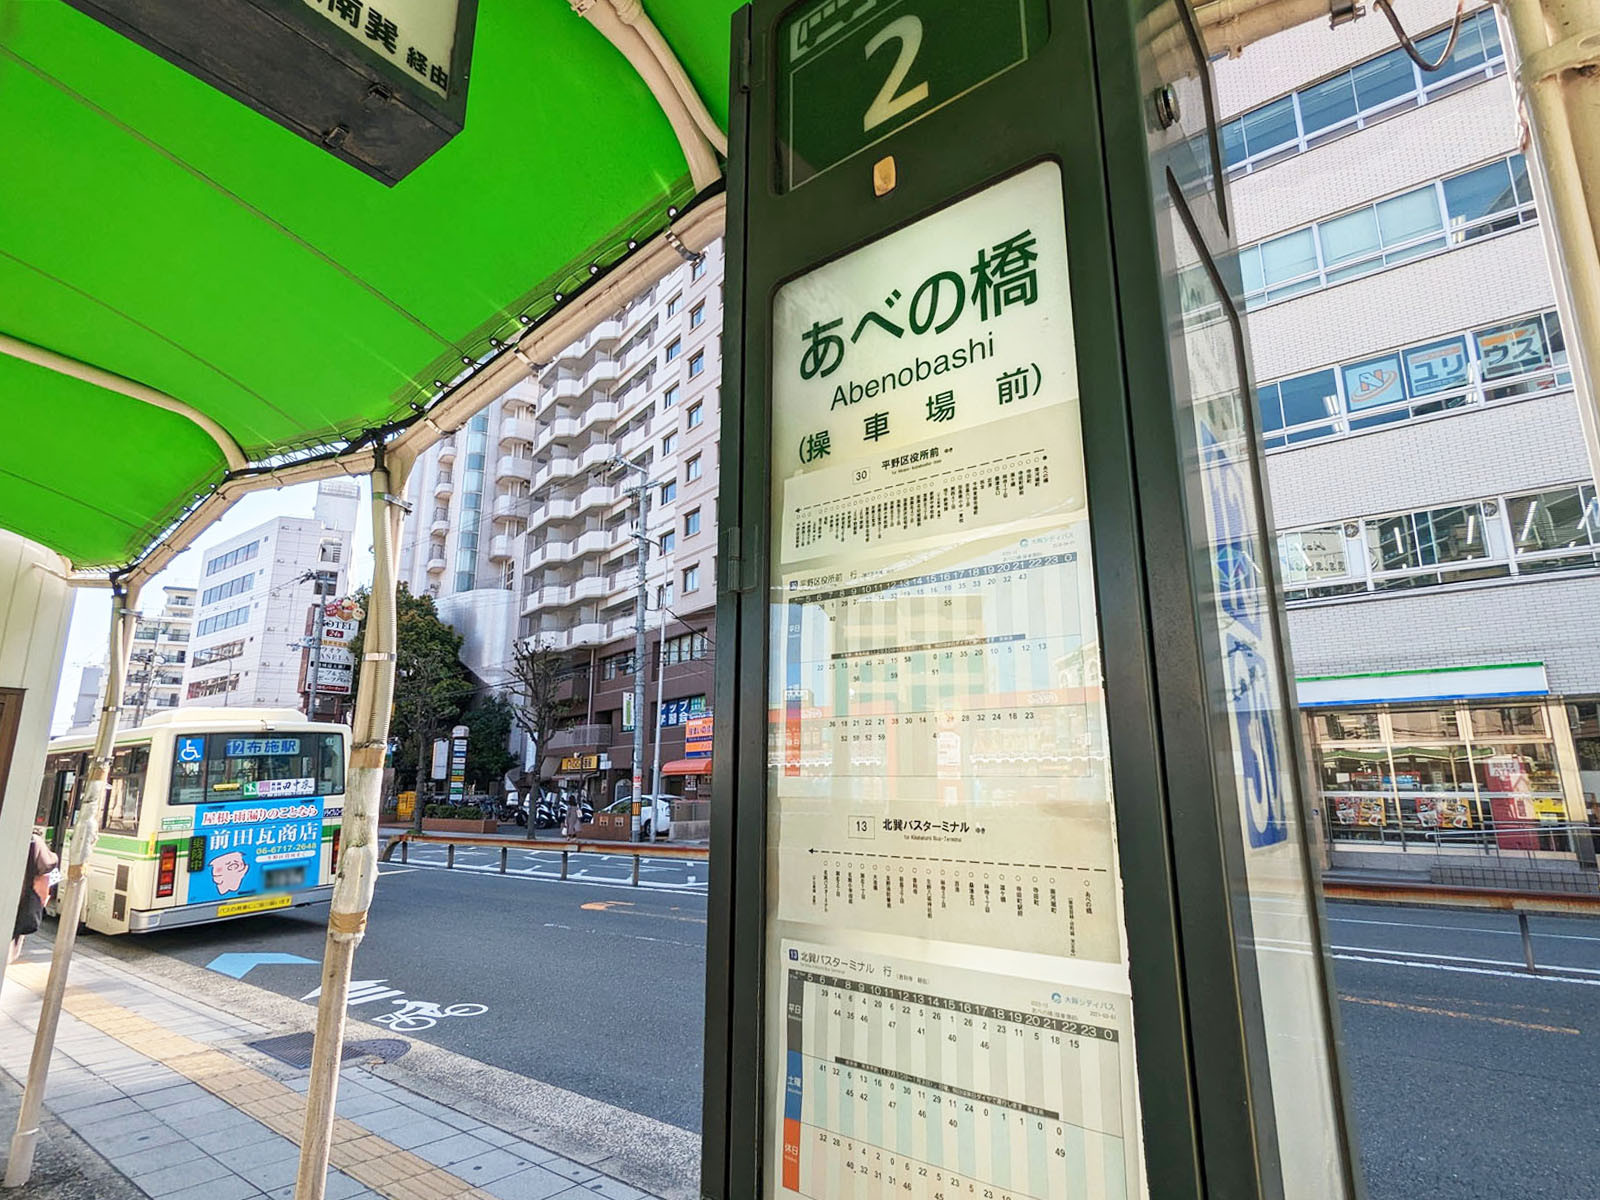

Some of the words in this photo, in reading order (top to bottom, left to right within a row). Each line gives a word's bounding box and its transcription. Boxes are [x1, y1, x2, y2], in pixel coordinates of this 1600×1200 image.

[406, 46, 448, 92] 経由
[864, 14, 929, 132] 2
[800, 229, 1038, 380] あべの橋
[830, 331, 995, 411] Abenobashi
[856, 470, 867, 481] 30
[862, 585, 871, 593] 10
[228, 741, 243, 754] 12
[247, 739, 297, 754] 布施駅
[203, 805, 318, 825] 屋根・雨漏りのことなら
[856, 821, 867, 832] 13
[882, 817, 970, 833] 北巽バスターミナル
[210, 823, 318, 850] 前田瓦商店
[801, 951, 875, 974] 北巽バスターミナル
[883, 965, 892, 978] 行
[820, 976, 825, 984] 6
[859, 984, 864, 992] 9
[872, 986, 881, 995] 10
[885, 988, 894, 997] 11
[898, 992, 908, 1001] 12
[913, 994, 924, 1004] 13
[928, 997, 940, 1006] 14
[944, 1001, 955, 1010] 15
[959, 1004, 971, 1013] 16
[975, 1006, 988, 1015] 17
[992, 1009, 1005, 1019] 18
[1009, 1013, 1022, 1022] 19
[1026, 1016, 1040, 1026] 20
[1044, 1019, 1056, 1030] 21
[1062, 1022, 1077, 1034] 22
[1081, 1026, 1096, 1037] 23
[1104, 1030, 1112, 1039] 0
[902, 1006, 911, 1014] 22
[997, 1025, 1006, 1034] 23
[1015, 1028, 1023, 1037] 11
[1070, 1039, 1079, 1049] 15
[918, 1091, 925, 1099] 11
[949, 1099, 956, 1107] 11
[965, 1103, 974, 1112] 24
[983, 1108, 989, 1116] 0
[1037, 1122, 1043, 1130] 0
[1056, 1127, 1062, 1136] 0
[1055, 1148, 1065, 1158] 49
[875, 1170, 881, 1179] 31
[889, 1176, 896, 1185] 31
[876, 1152, 880, 1160] 2
[918, 1167, 927, 1176] 22
[951, 1177, 960, 1187] 23
[984, 1189, 993, 1199] 23
